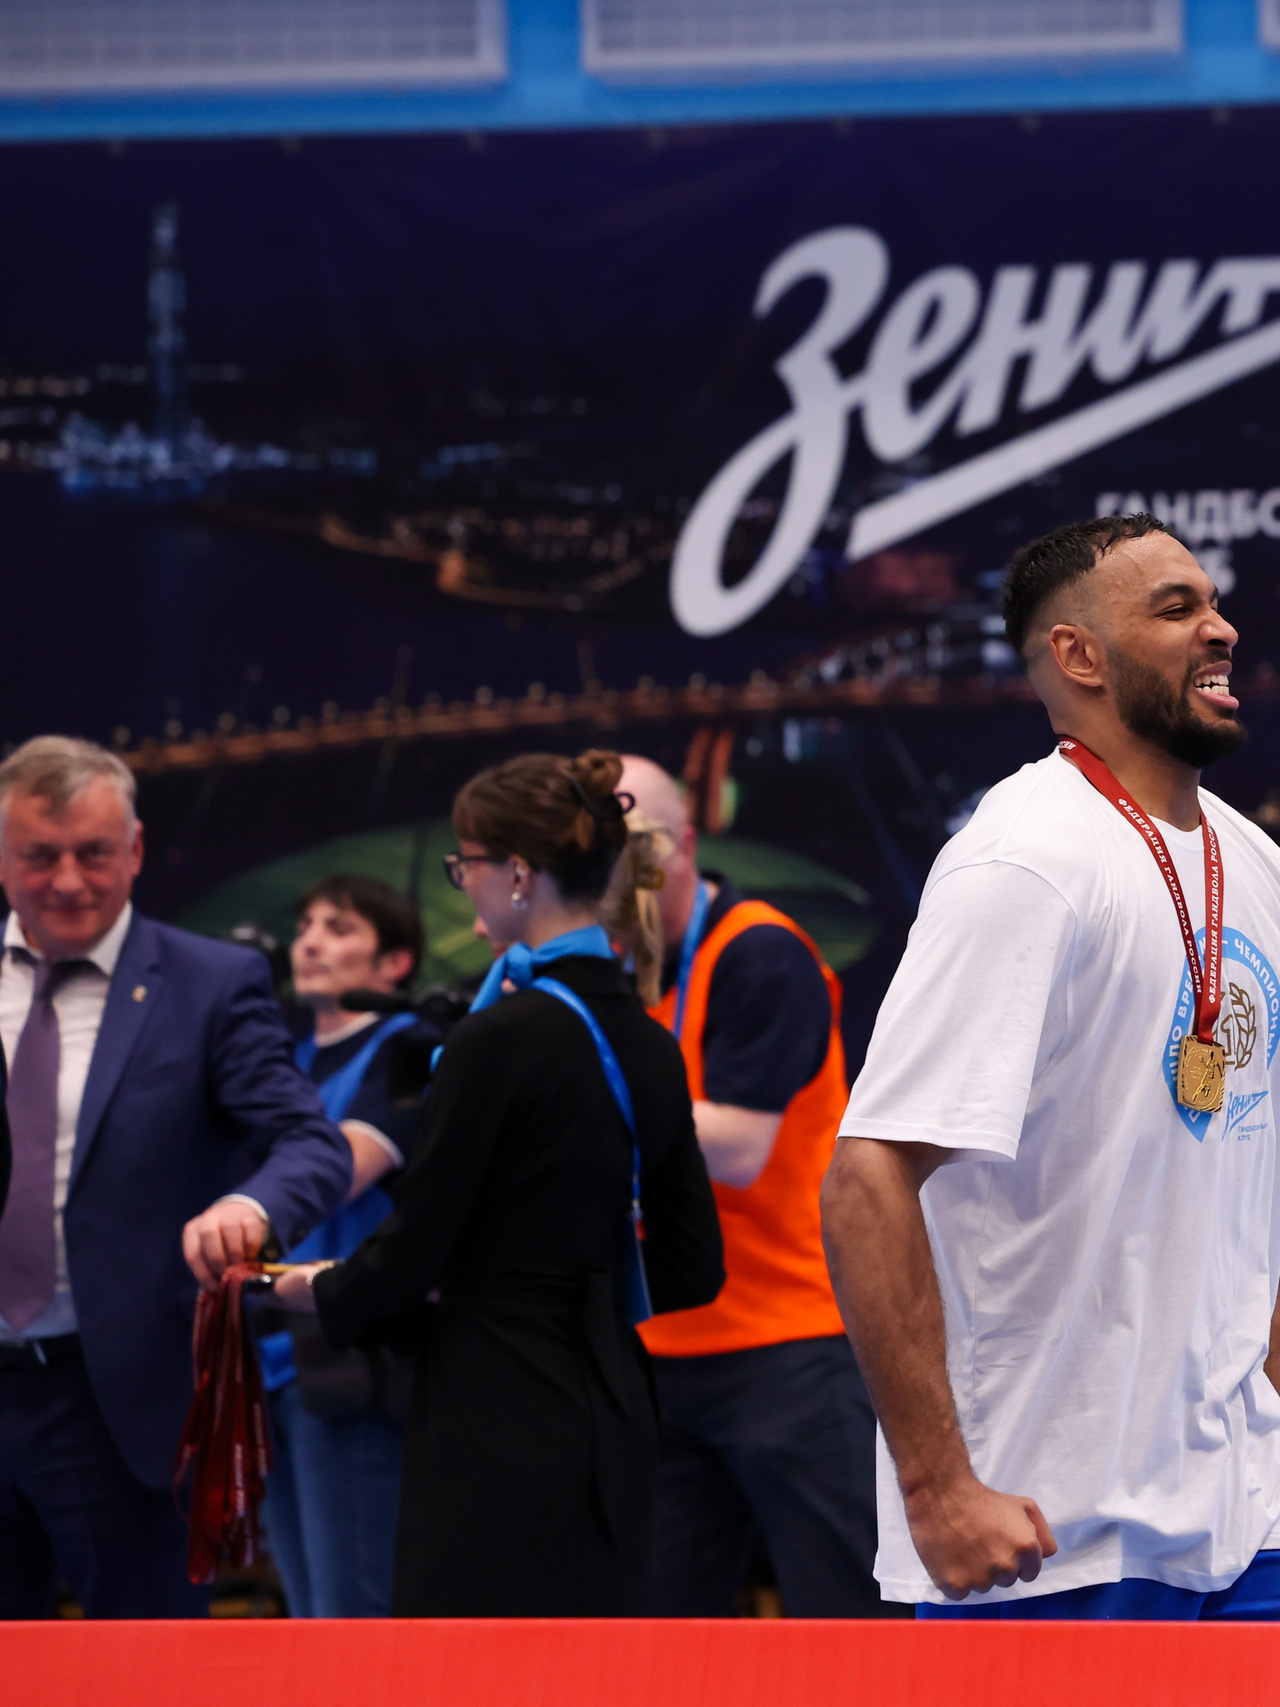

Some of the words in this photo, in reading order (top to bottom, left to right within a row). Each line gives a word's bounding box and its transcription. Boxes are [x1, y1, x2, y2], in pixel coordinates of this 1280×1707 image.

[1118, 798, 1168, 863] ФЕДЕРАЦИЯ
[1187, 940, 1202, 993] РОССИИ
[1208, 929, 1218, 1004] ФЕДЕРАЦИЯ
